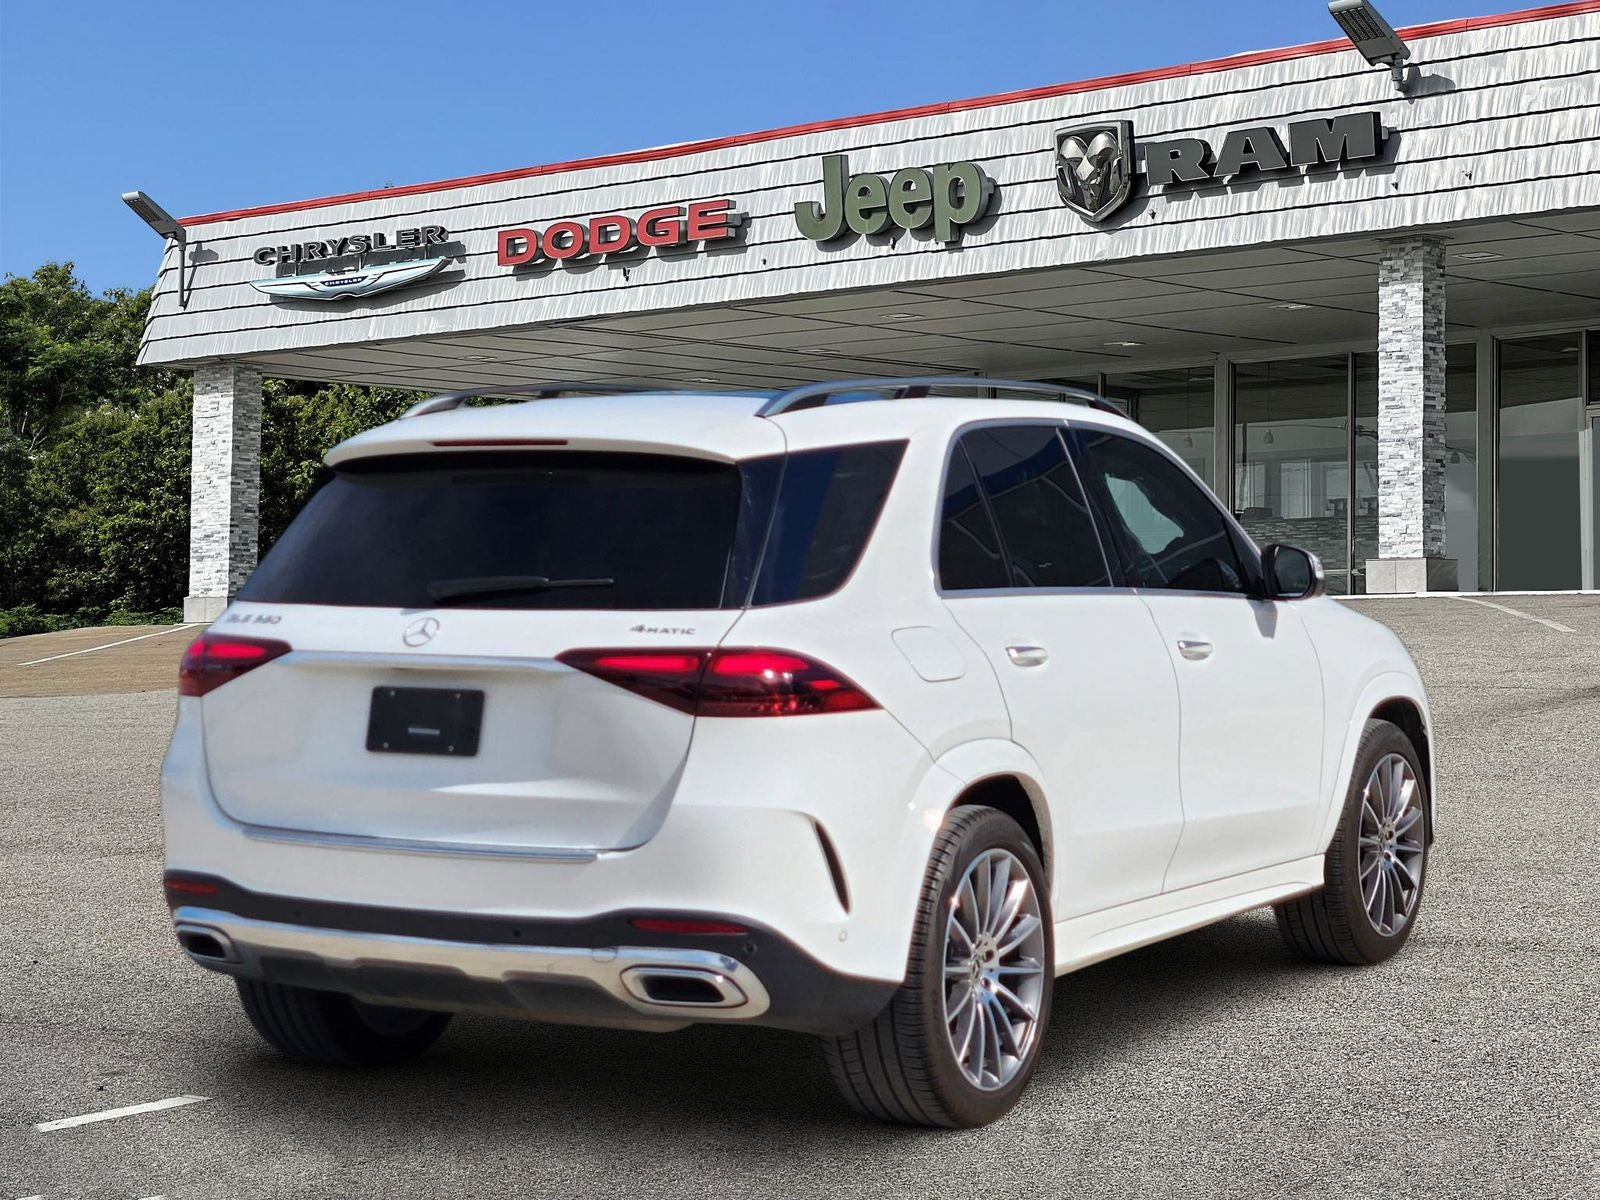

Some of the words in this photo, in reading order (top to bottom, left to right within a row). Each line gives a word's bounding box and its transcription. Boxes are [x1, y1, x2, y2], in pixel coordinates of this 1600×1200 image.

[1145, 112, 1381, 188] RAM
[497, 199, 735, 267] DODGE
[795, 154, 985, 243] Jeep
[253, 225, 448, 266] CHRYSLER
